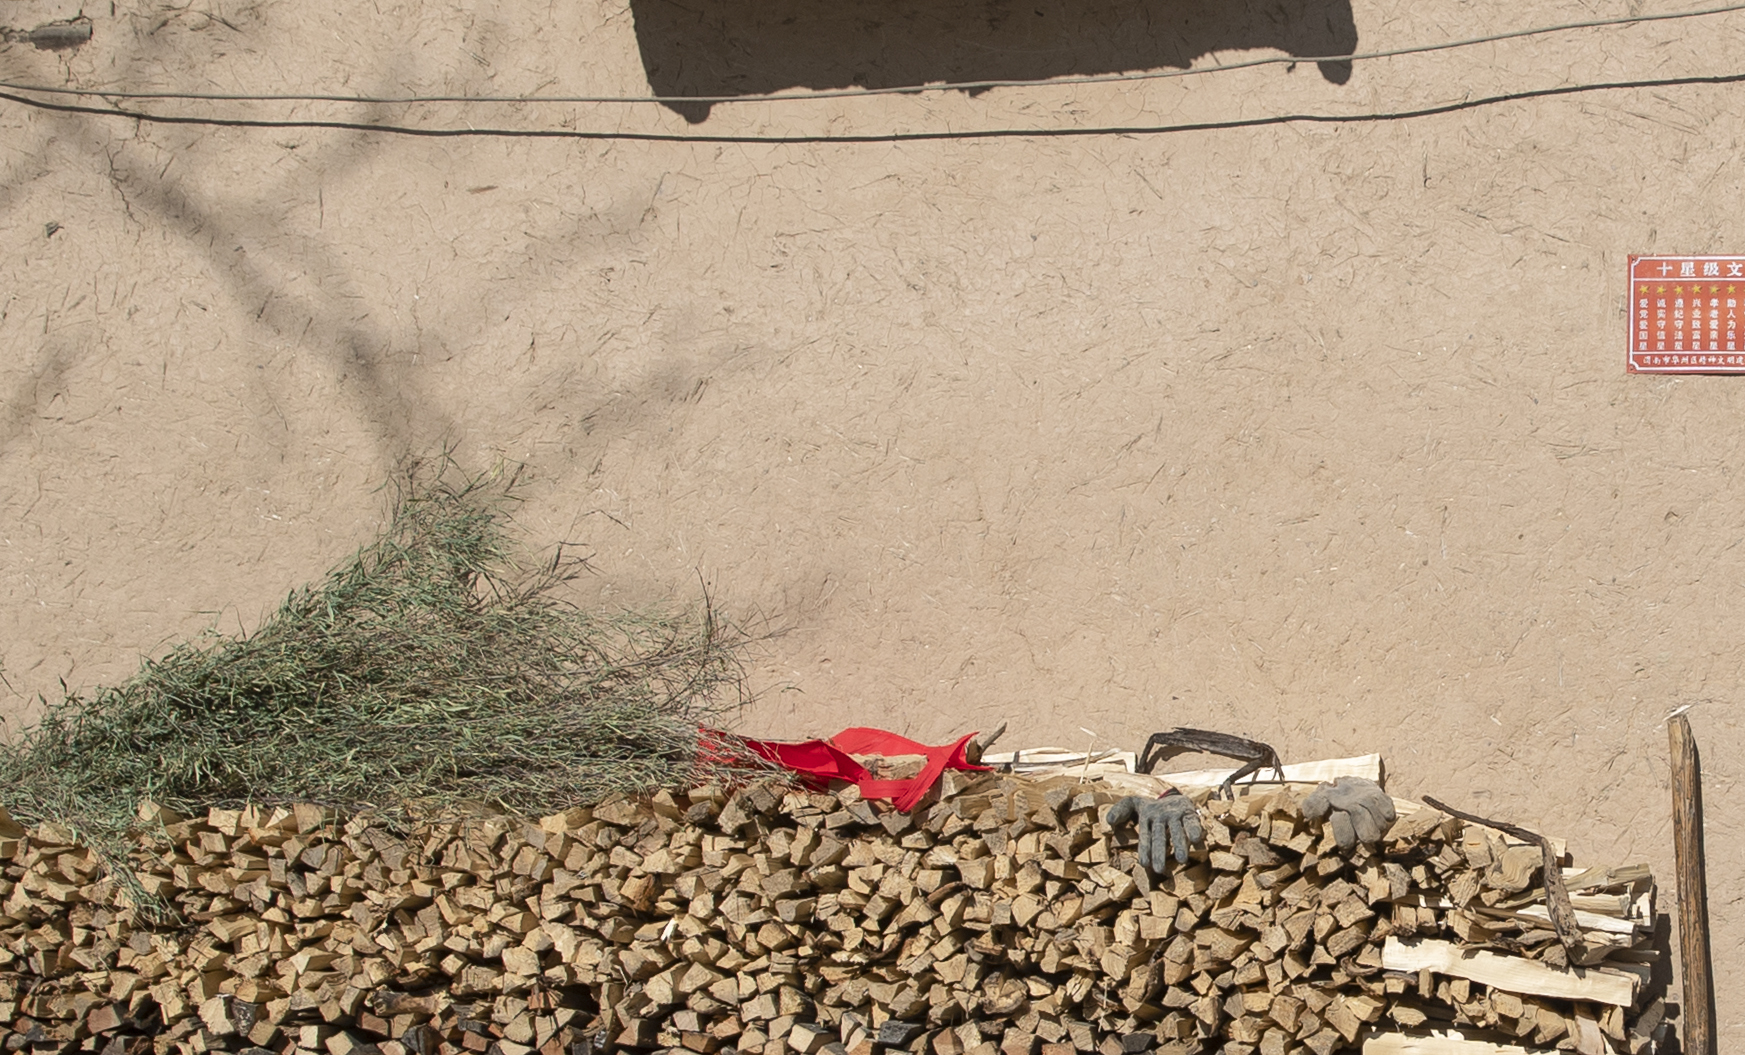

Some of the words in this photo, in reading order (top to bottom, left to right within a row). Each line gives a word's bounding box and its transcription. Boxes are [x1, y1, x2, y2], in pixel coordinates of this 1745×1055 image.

[1639, 298, 1649, 351] 爱党爱国星
[1656, 298, 1667, 351] 诚实守信星
[1674, 298, 1684, 351] 遵纪守法星
[1691, 298, 1702, 351] 兴业致富星
[1709, 298, 1719, 351] 孝老爱亲星
